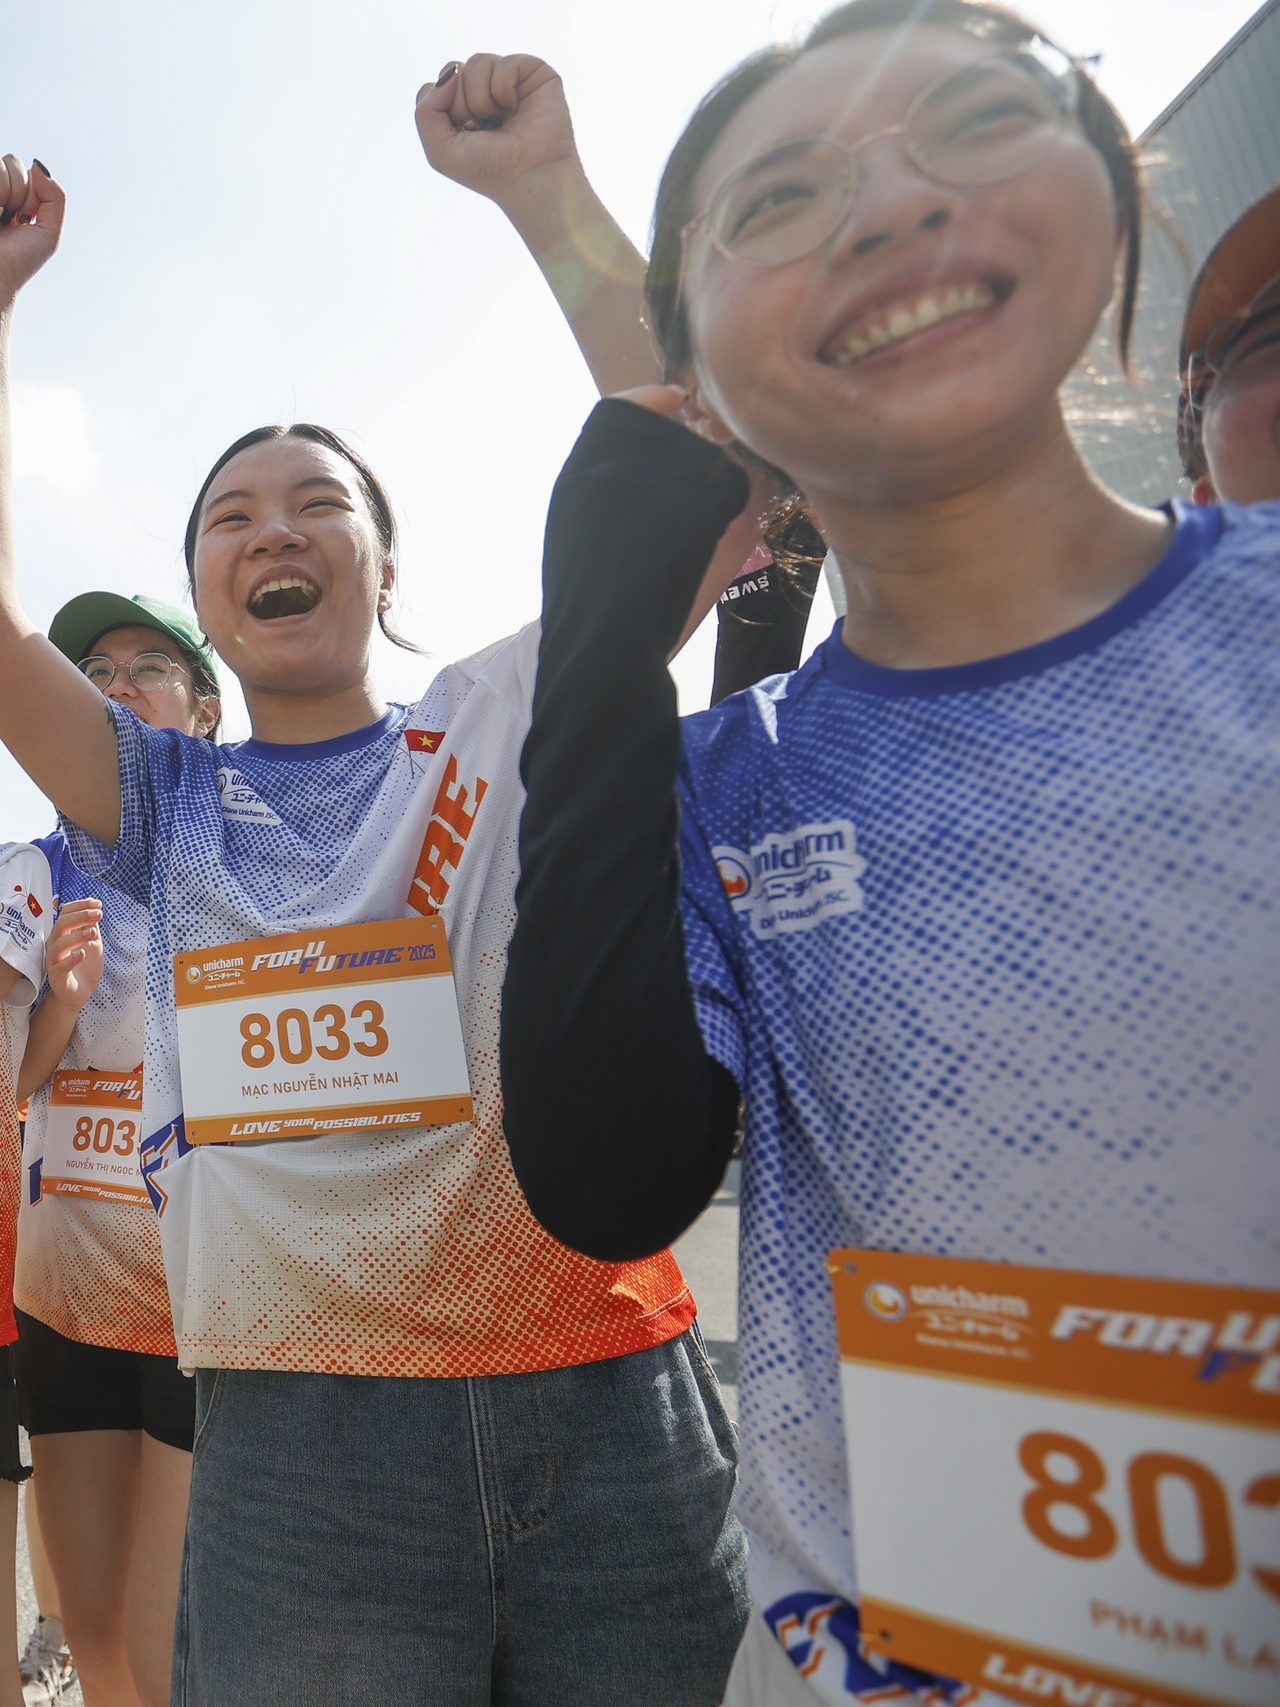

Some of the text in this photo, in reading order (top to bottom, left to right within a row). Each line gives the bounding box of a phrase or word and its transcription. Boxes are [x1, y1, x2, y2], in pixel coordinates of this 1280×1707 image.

[203, 957, 244, 972] unicharm
[408, 943, 437, 961] 2025
[239, 999, 389, 1069] 8033
[241, 1071, 399, 1100] MẠC NGUYỄN NHẬT MAI
[72, 1115, 142, 1157] 803
[230, 1111, 422, 1136] LOVE YOUR POSSIBILITIES
[65, 1158, 94, 1171] NGUYỄN
[96, 1162, 109, 1175] THỊ
[110, 1165, 134, 1177] NGỌC
[56, 1182, 83, 1192] LOVE
[82, 1185, 102, 1193] YOUR
[910, 1283, 1030, 1319] unicharm
